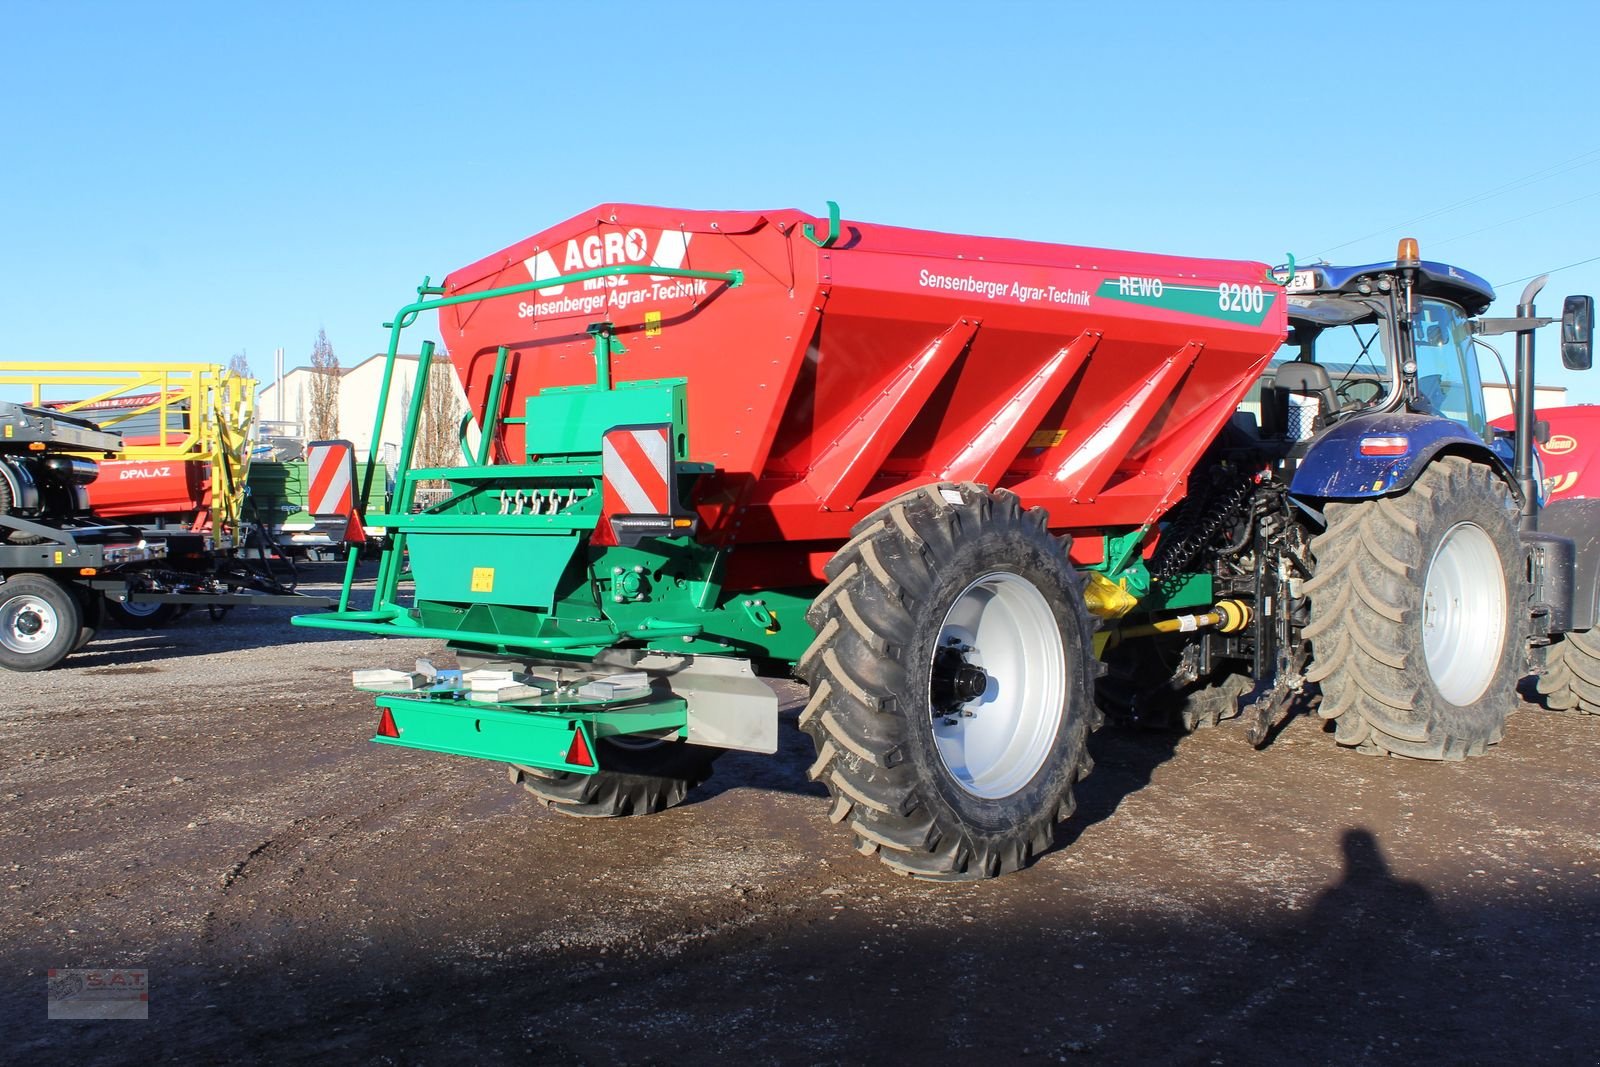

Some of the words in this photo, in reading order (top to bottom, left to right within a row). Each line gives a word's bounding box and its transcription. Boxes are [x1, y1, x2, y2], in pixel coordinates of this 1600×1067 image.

[564, 228, 647, 271] AGRO
[517, 294, 607, 318] Sensenberger
[608, 278, 708, 310] Agrar-Technik
[919, 269, 1009, 299] Sensenberger
[1010, 281, 1091, 306] Agrar-Technik
[1119, 276, 1163, 298] REWO
[1218, 282, 1264, 314] 8200
